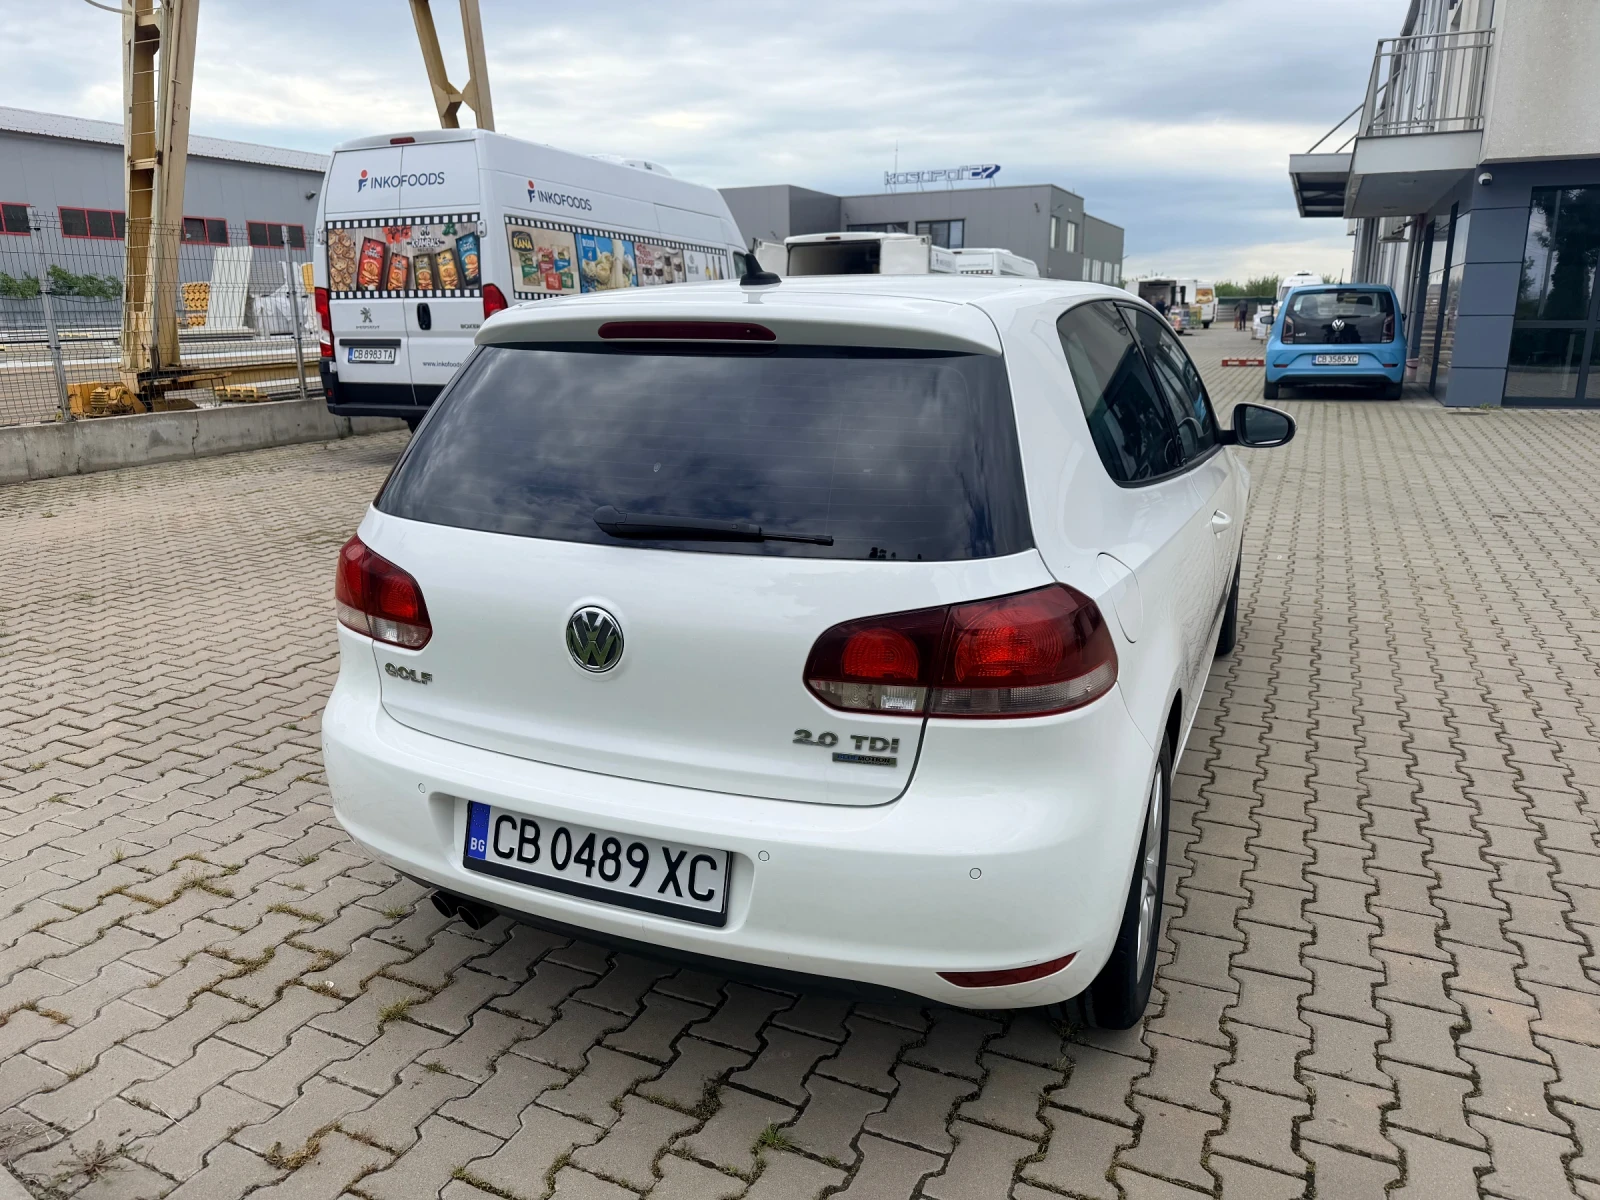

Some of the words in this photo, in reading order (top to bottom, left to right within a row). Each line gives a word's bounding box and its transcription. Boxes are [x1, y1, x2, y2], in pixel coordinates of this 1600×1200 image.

[371, 172, 445, 189] INKOFOODS
[537, 190, 592, 211] INKOFOODS
[513, 237, 533, 249] RANA
[353, 349, 363, 360] CB
[364, 349, 382, 360] 8983
[383, 349, 393, 360] TA
[1317, 355, 1327, 363] CB
[384, 662, 433, 685] GOLF
[792, 729, 839, 748] 2.0
[850, 734, 900, 754] TDI
[470, 837, 486, 852] BG
[493, 814, 541, 864] CB
[550, 826, 650, 888] 0489
[657, 846, 718, 902] XC
